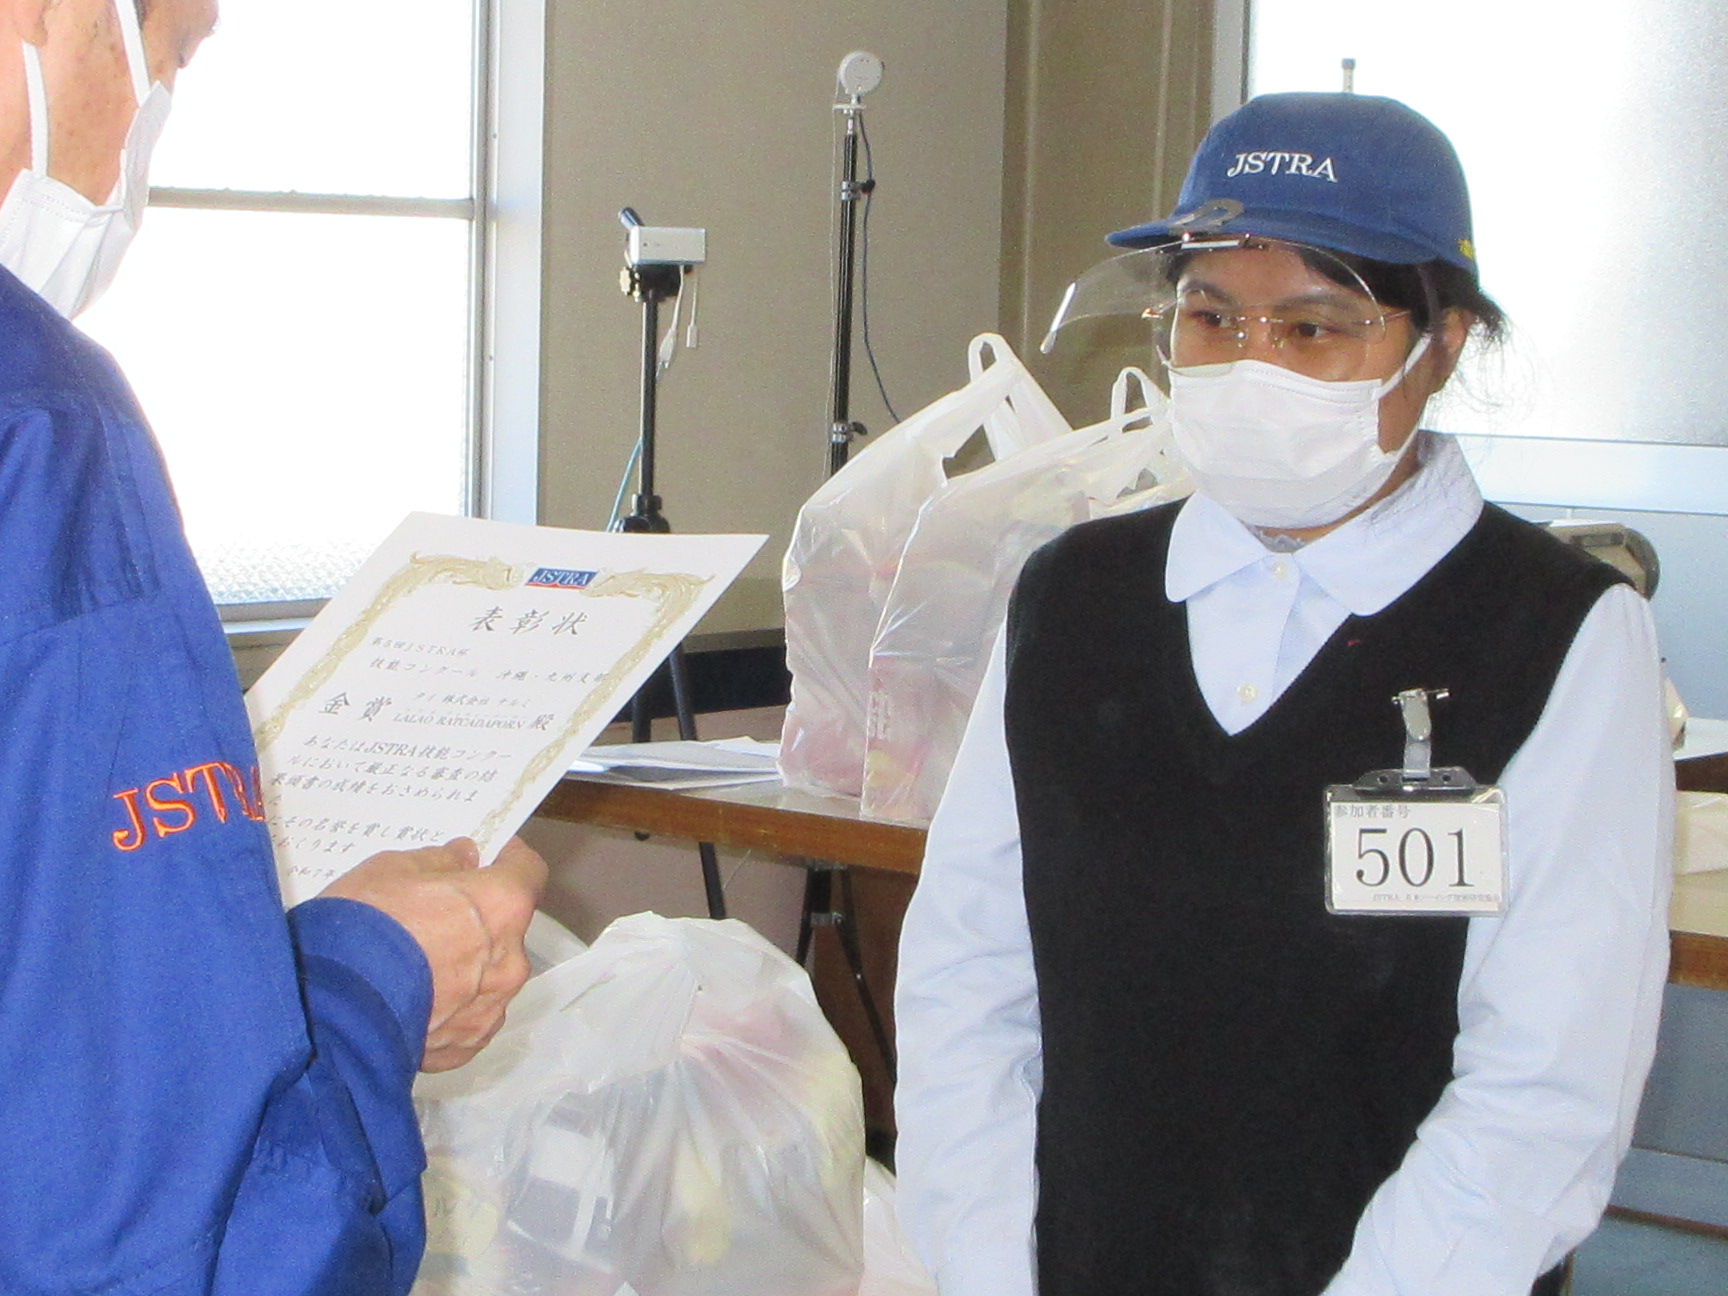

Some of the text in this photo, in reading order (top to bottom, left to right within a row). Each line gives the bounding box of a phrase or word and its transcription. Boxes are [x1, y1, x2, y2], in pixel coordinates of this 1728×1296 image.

[1227, 150, 1338, 183] JSTRA
[533, 570, 589, 585] JSTRA
[469, 605, 589, 636] 表彰状
[318, 691, 392, 723] 金賞
[1356, 827, 1475, 888] 501
